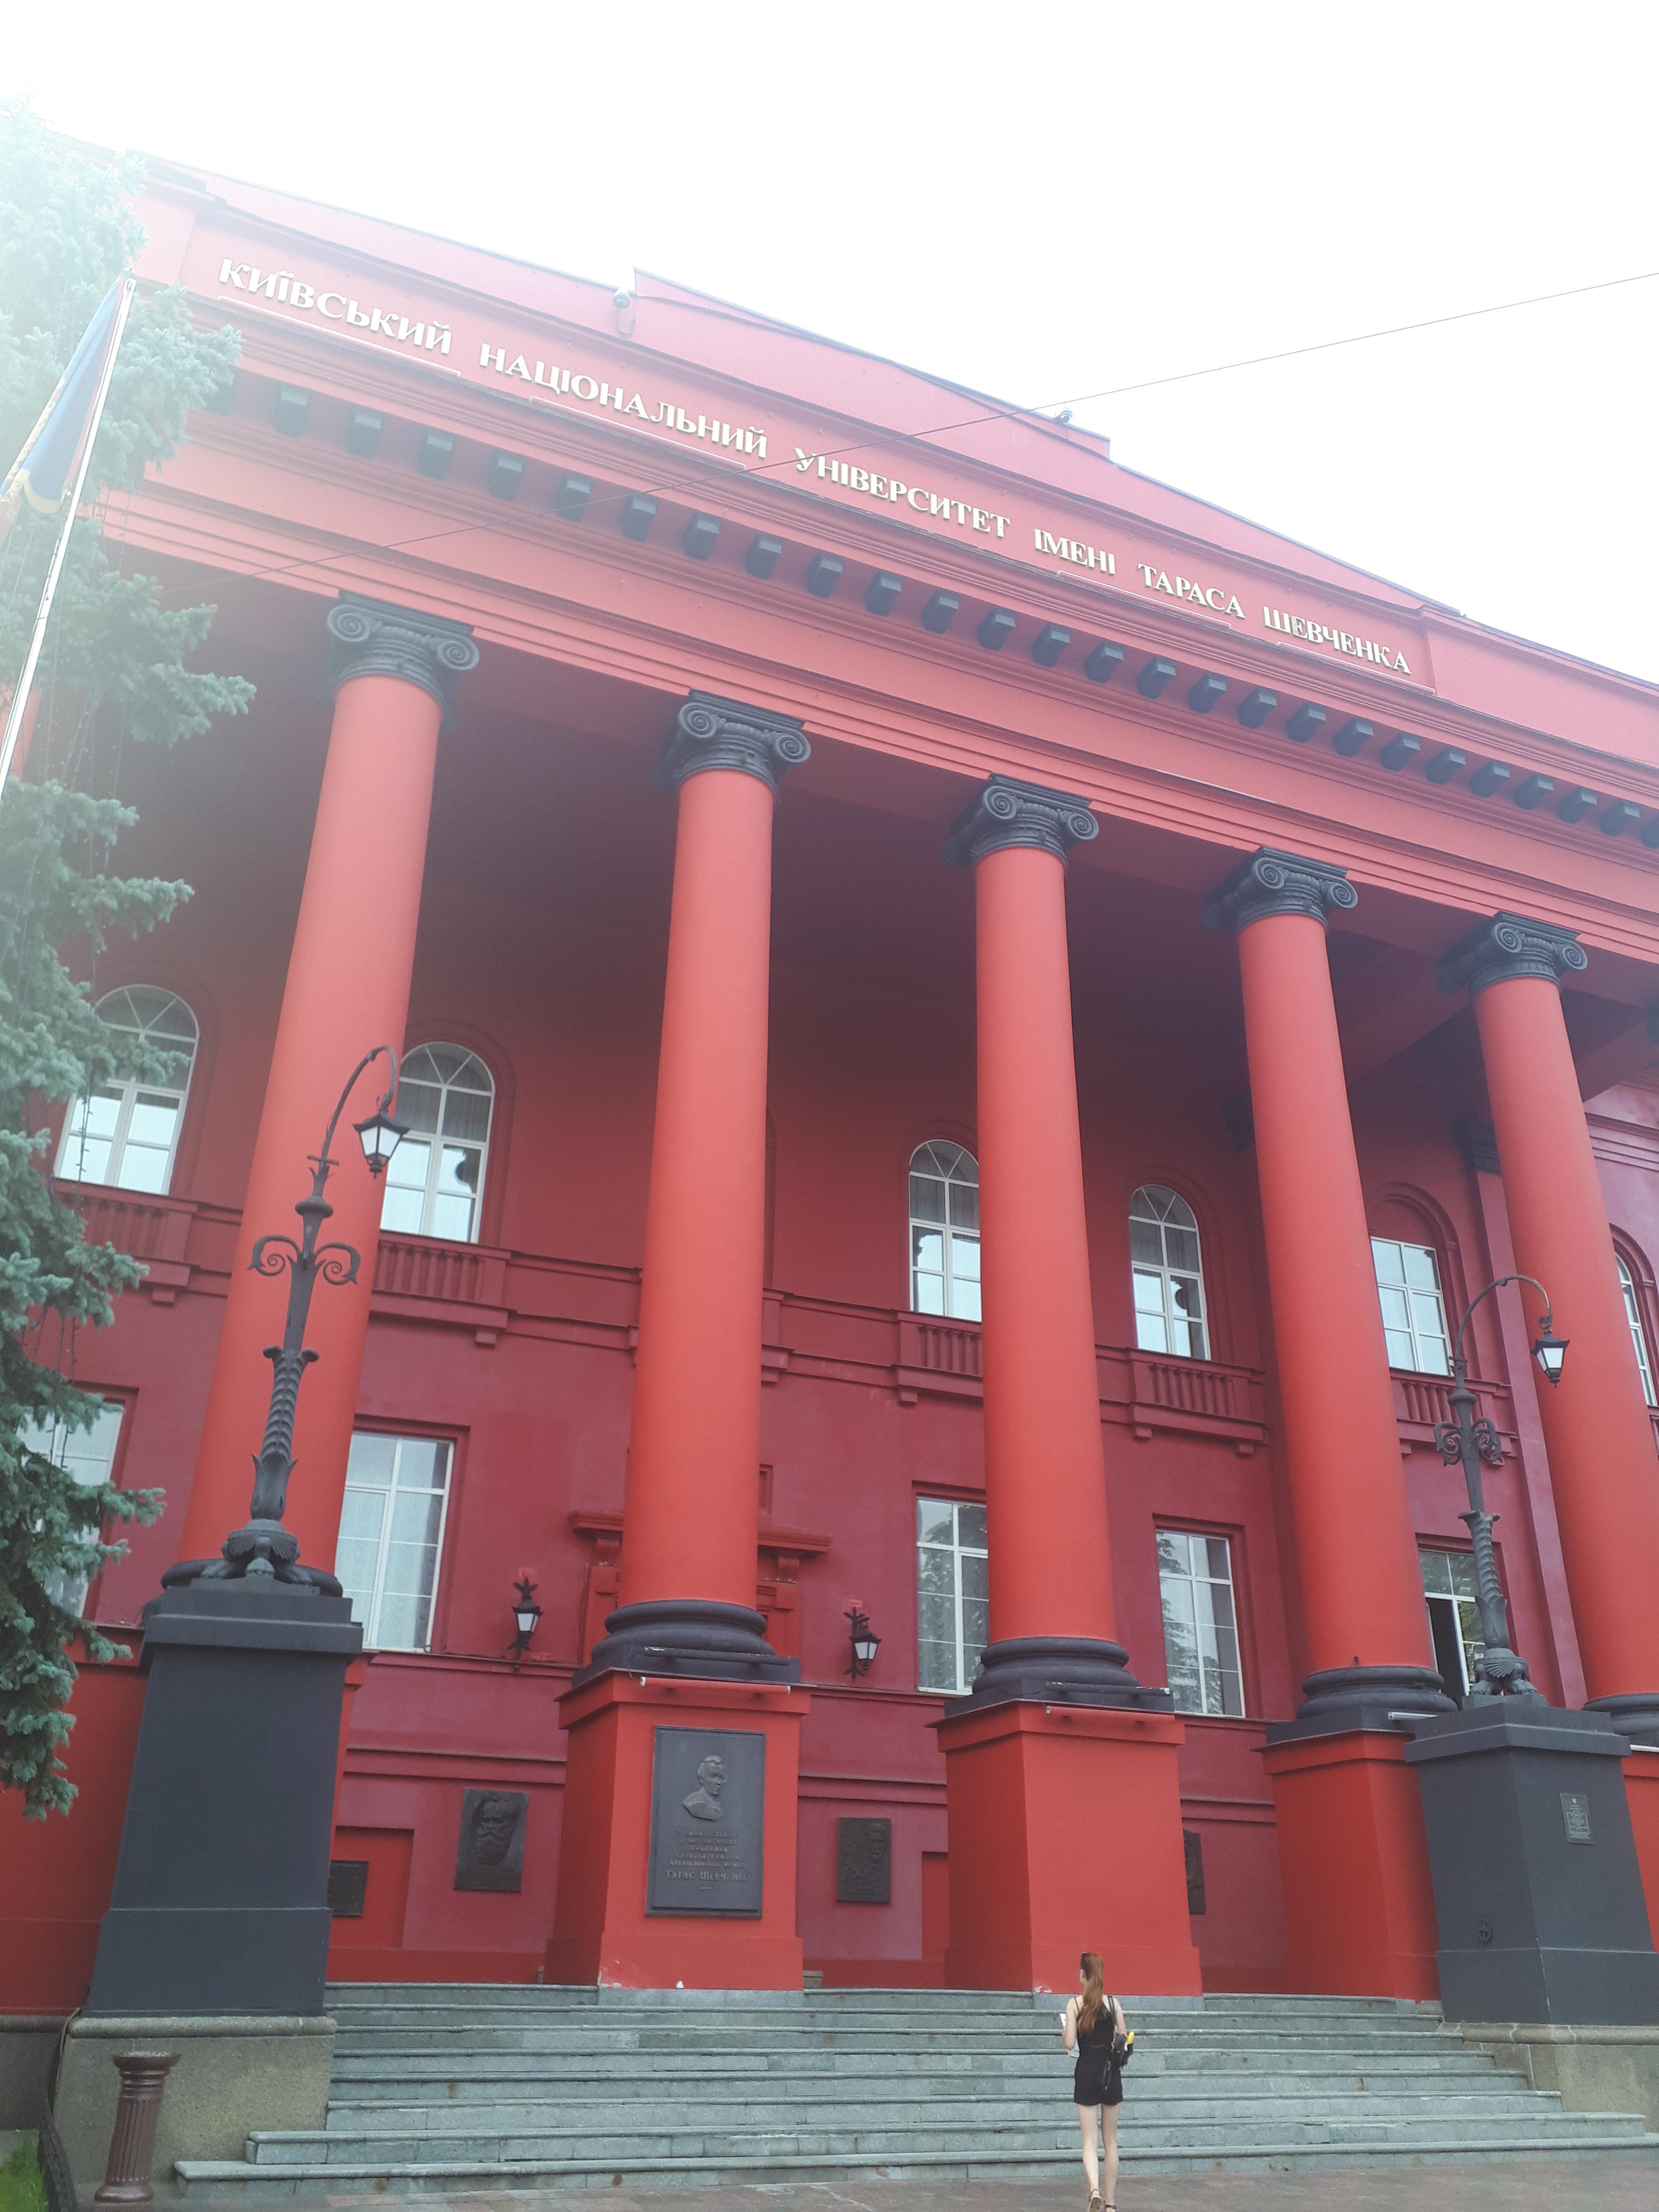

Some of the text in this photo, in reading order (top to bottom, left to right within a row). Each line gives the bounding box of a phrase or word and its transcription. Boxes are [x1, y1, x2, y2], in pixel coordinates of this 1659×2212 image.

[218, 258, 1412, 675] КИЇВСЬКИЙ НАЦІОНАЛЬНИЙ УНІВЕРСИТЕТ ІМЕНІ ТАРАСА ШЕВЧЕНКА
